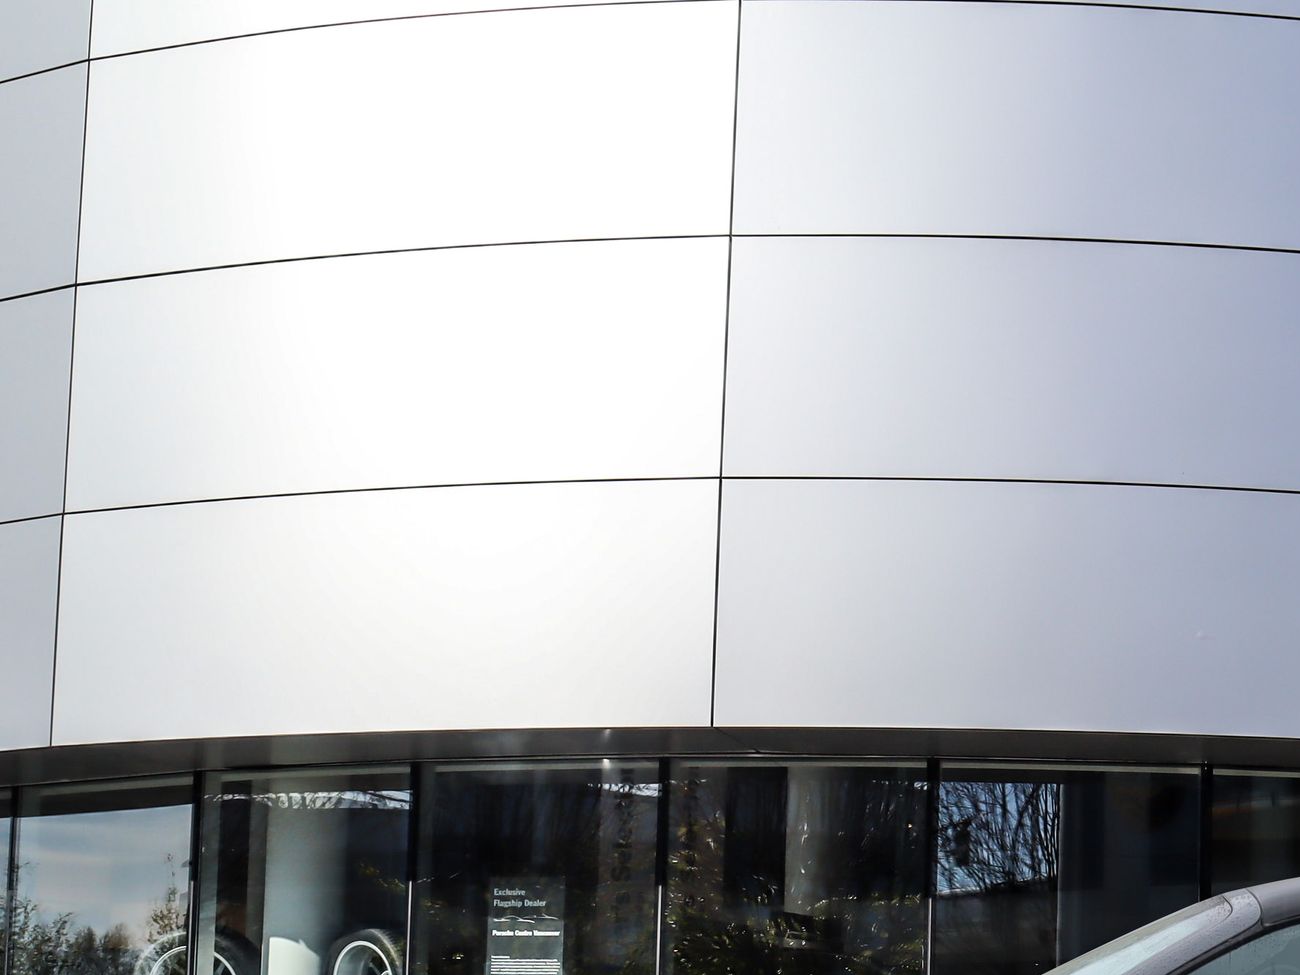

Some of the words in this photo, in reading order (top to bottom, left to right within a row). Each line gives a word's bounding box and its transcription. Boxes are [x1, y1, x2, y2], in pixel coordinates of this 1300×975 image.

[493, 888, 526, 896] Exclusive
[493, 899, 523, 908] Flagship
[524, 899, 547, 907] Dealer
